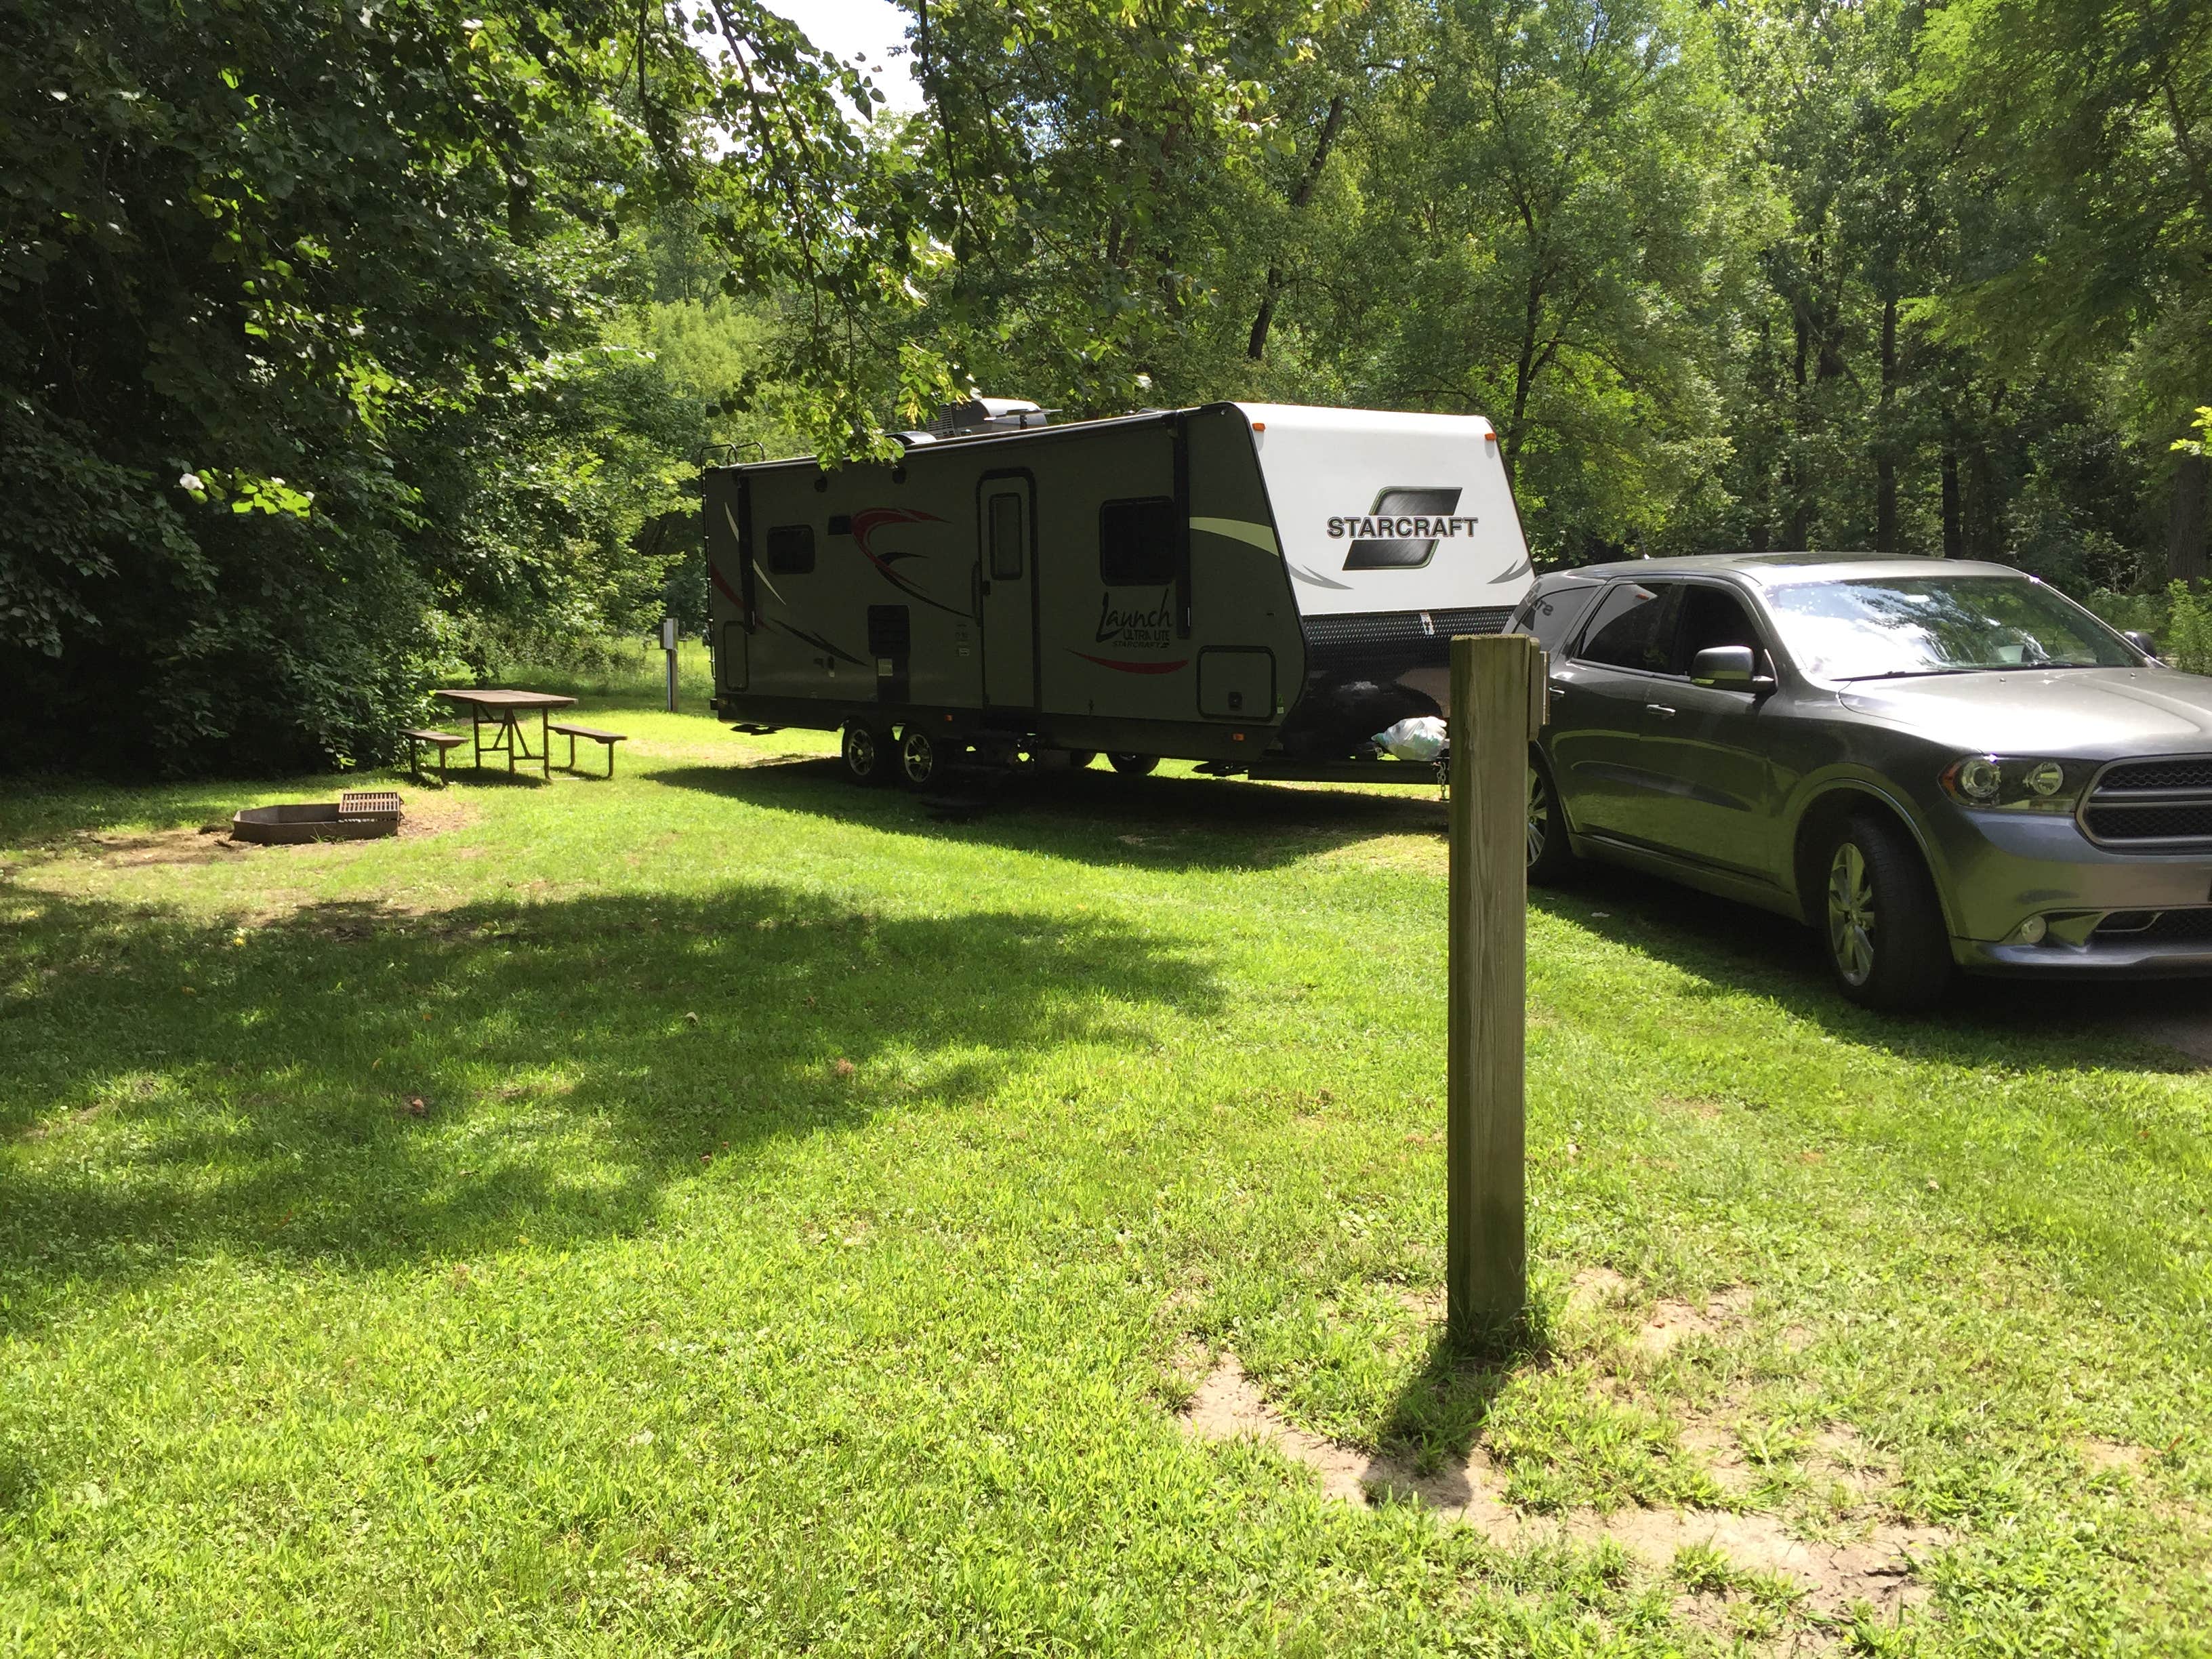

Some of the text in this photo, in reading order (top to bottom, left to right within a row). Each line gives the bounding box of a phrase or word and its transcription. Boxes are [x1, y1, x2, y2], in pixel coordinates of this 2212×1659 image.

[1327, 516, 1479, 538] STARCRAFT
[1096, 588, 1172, 642] Launch
[1123, 629, 1151, 640] ULTRA
[1113, 640, 1160, 649] STARCRAFT
